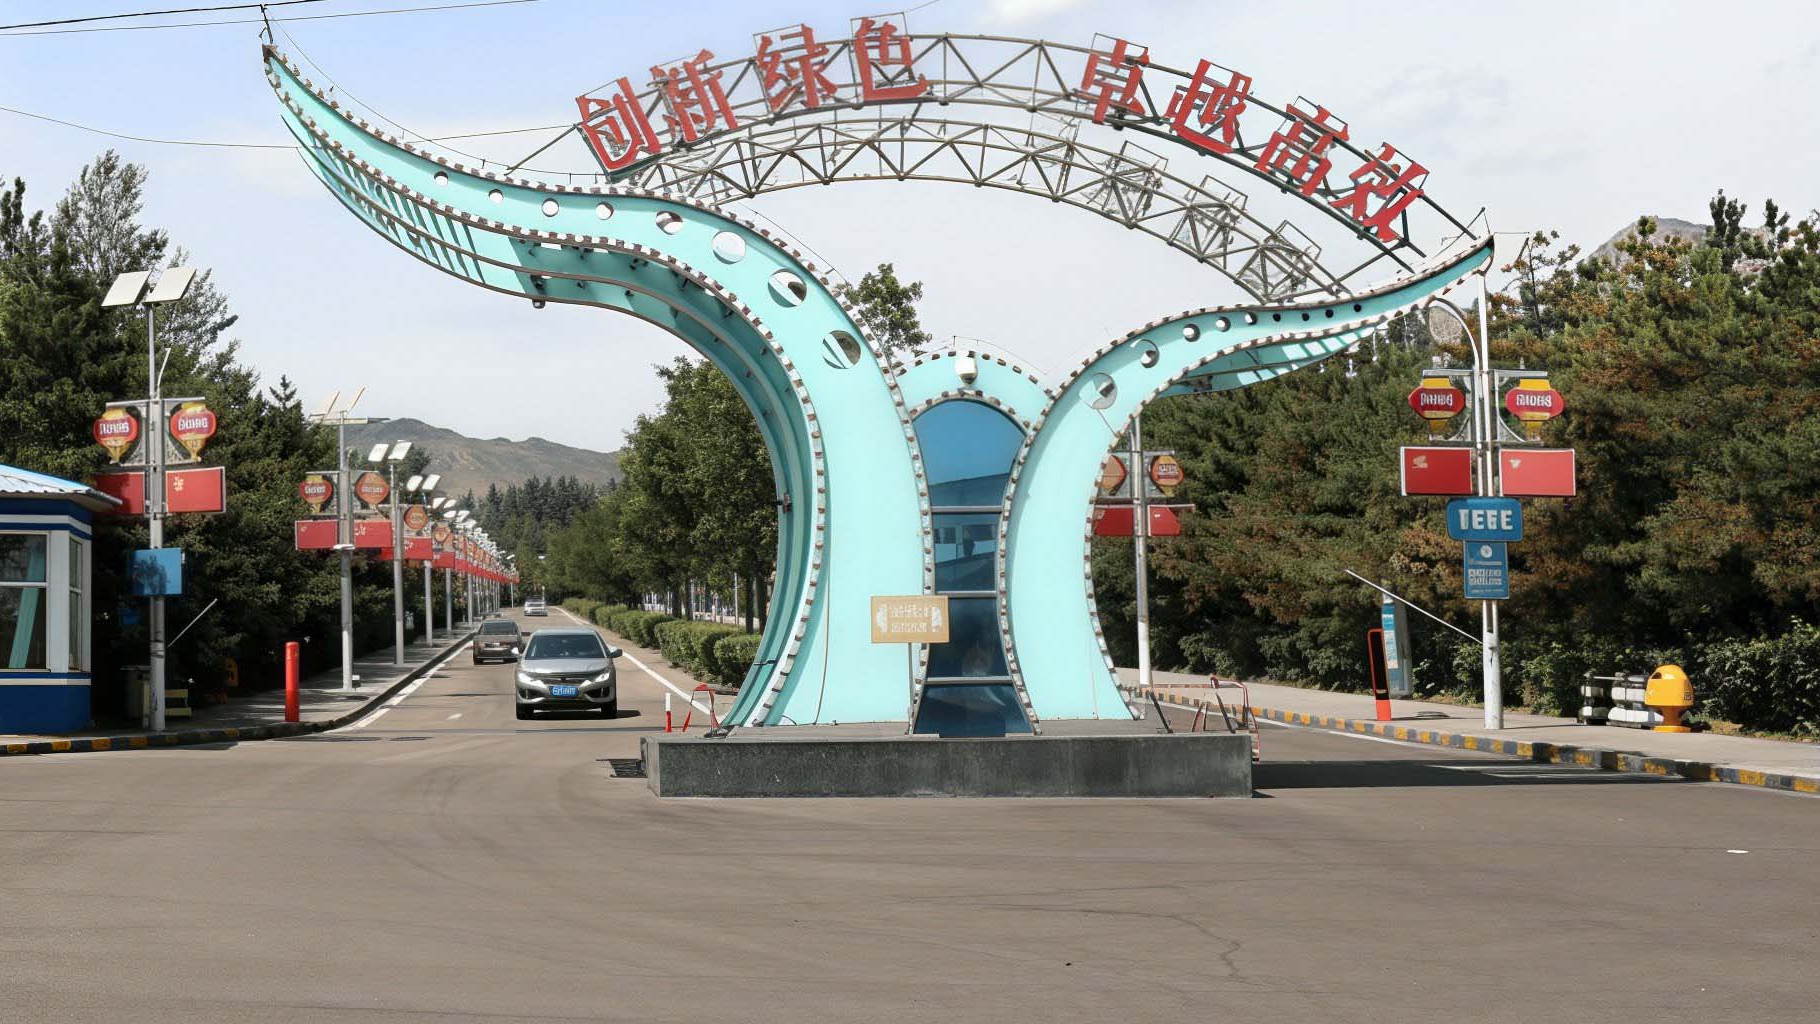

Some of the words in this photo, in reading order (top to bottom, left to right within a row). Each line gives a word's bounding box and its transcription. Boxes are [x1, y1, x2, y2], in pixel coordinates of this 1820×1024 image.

[575, 17, 929, 170] 创新绿色
[1081, 37, 1430, 243] 卓越高效
